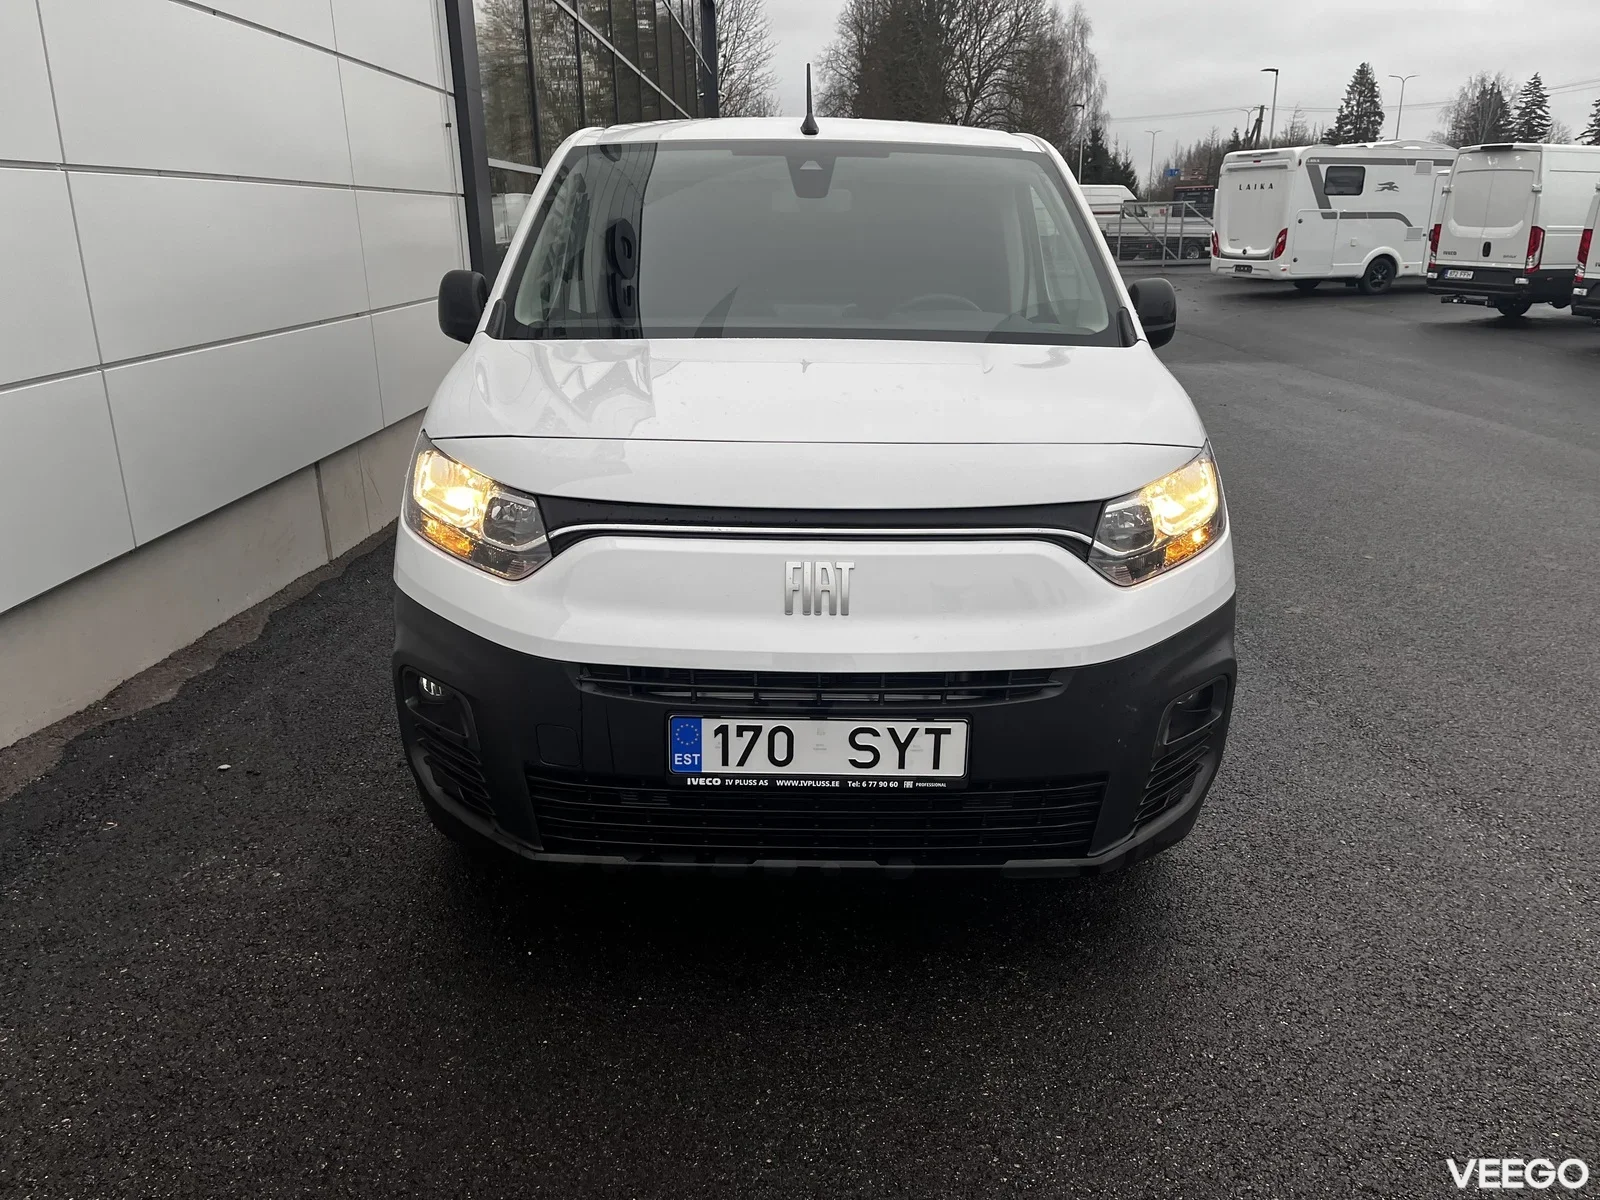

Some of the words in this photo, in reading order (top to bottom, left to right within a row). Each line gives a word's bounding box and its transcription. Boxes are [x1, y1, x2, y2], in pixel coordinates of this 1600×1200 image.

[784, 561, 855, 616] FIAT
[674, 753, 700, 765] EST
[714, 724, 794, 768] 170
[848, 726, 952, 770] SYT
